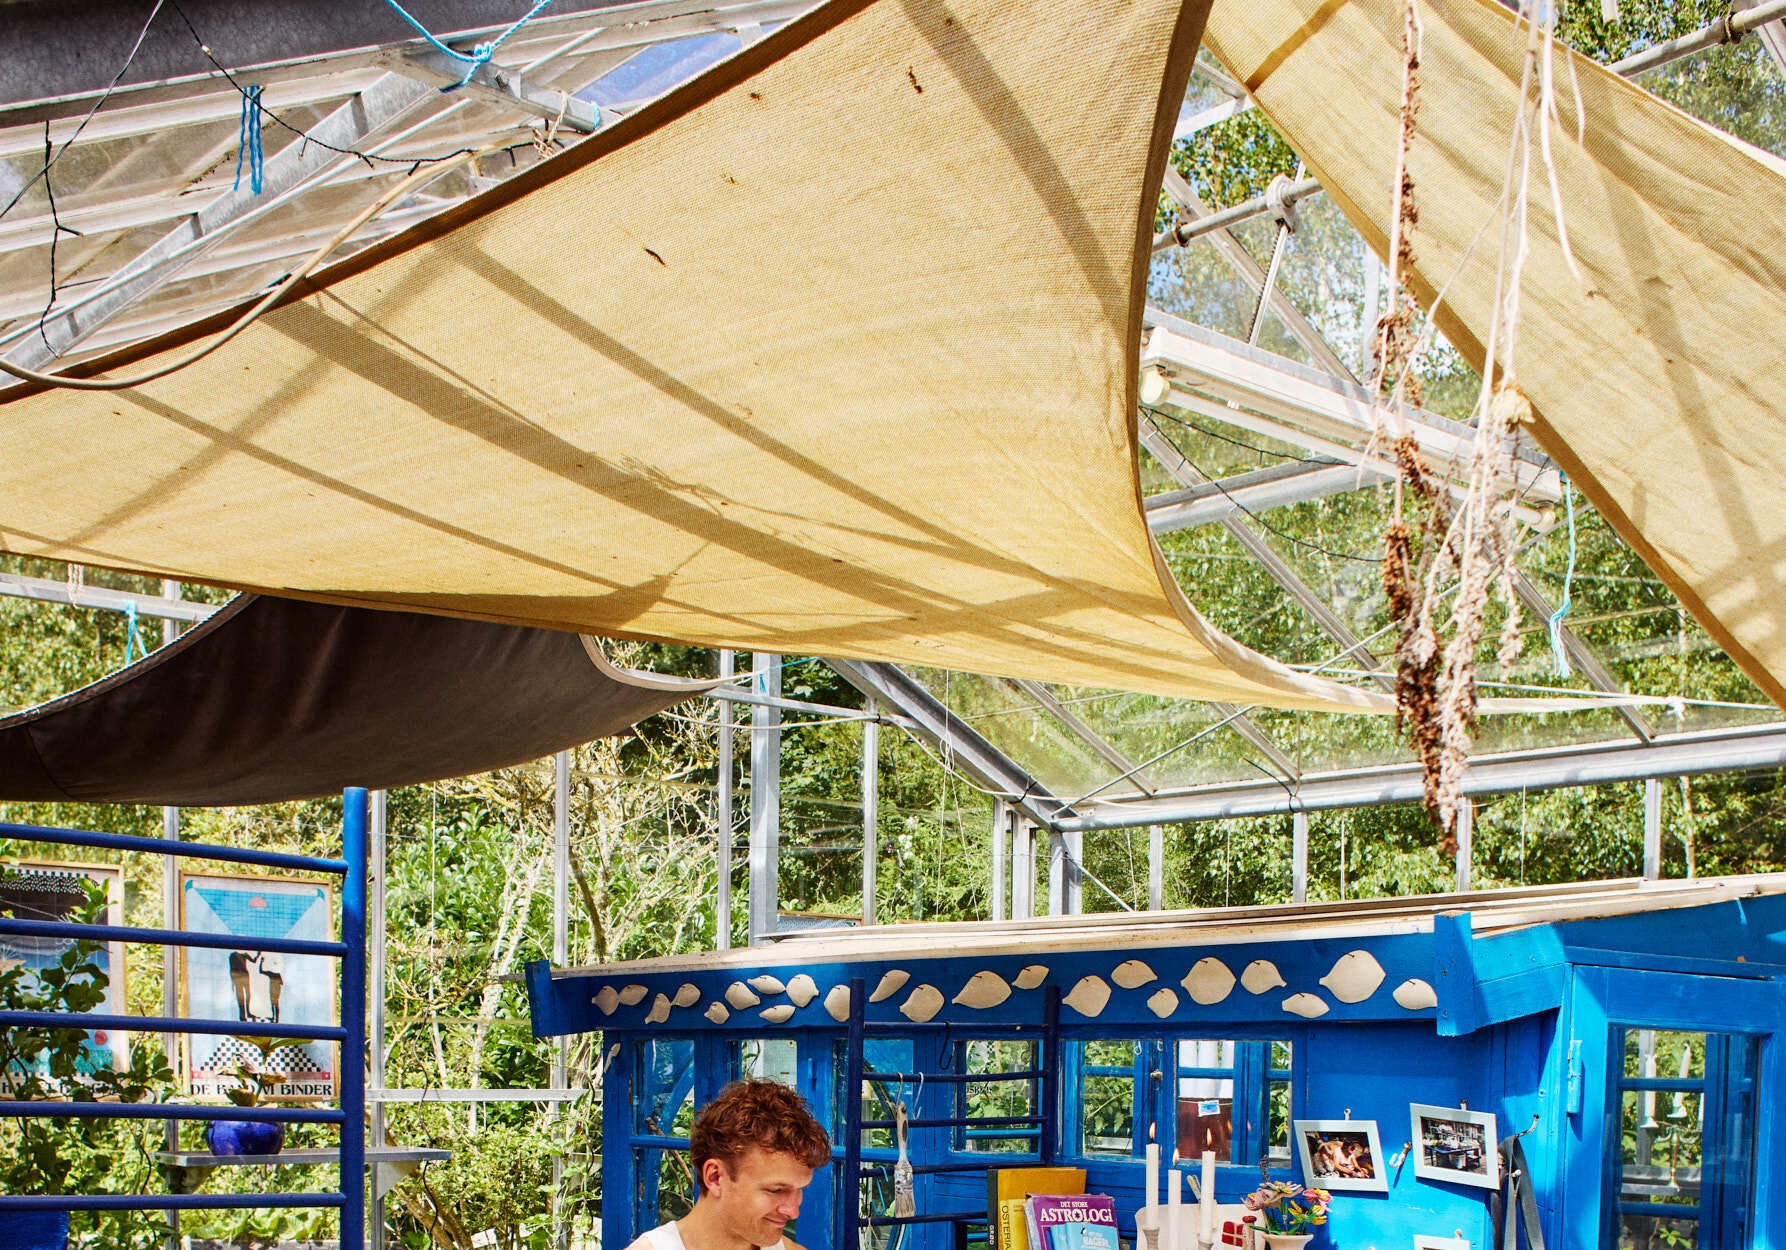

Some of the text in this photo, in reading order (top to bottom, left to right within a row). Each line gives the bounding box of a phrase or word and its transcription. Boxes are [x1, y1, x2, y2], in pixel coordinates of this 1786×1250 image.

[280, 1083, 333, 1096] BINDER
[1040, 1208, 1114, 1223] ASTROLOGI
[1001, 1205, 1012, 1250] OSTERIA
